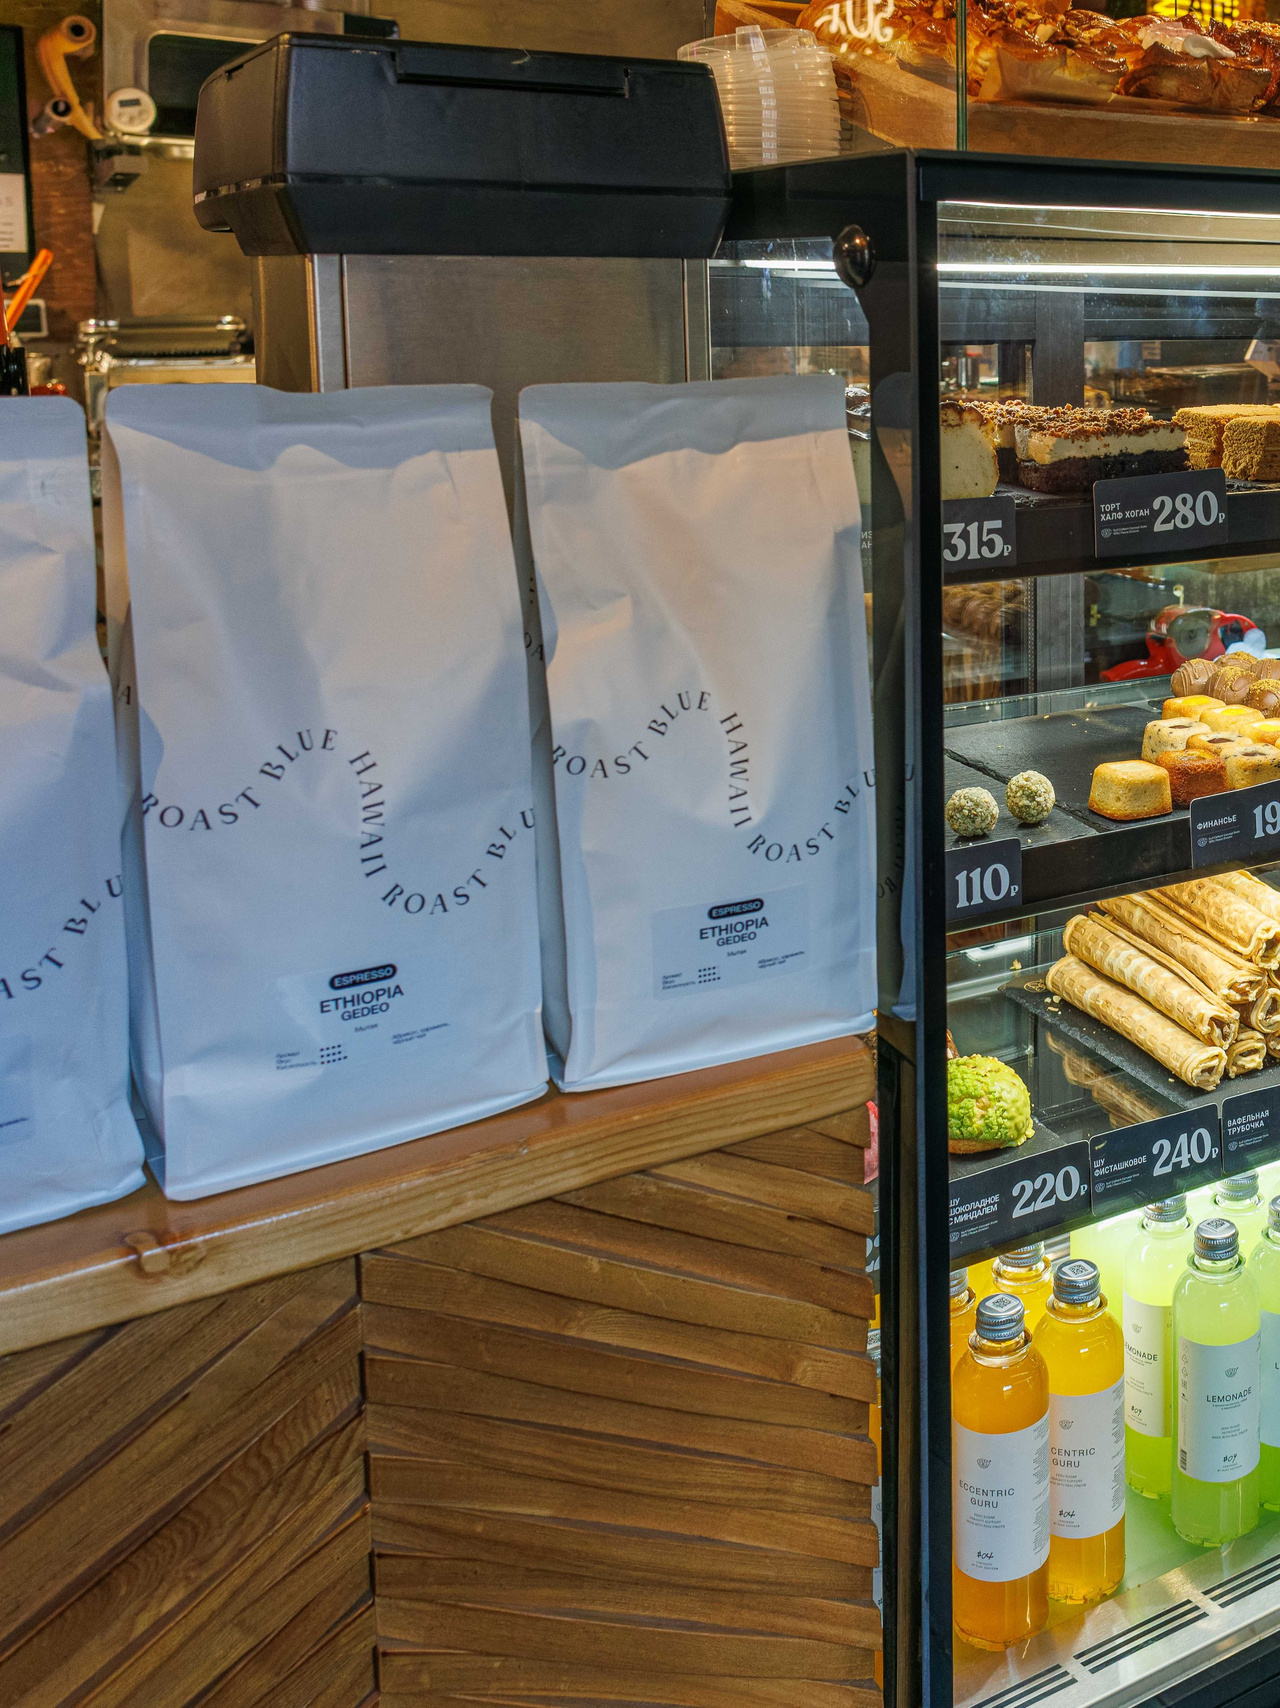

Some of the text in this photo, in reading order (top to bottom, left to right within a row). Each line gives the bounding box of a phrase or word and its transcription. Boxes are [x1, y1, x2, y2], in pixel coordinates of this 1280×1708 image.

[1100, 502, 1120, 512] ТОРТ
[1100, 512, 1124, 521] ХАЛФ
[1125, 508, 1150, 518] ХОГАН
[553, 690, 876, 863] ROAST BLUE HAWAII ROAST BLU
[142, 729, 536, 915] ROAST BLUE HAWAII ROAST BLU
[1196, 814, 1237, 830] ФИНАНСЬЕ
[712, 900, 761, 917] ESPRESSO
[0, 874, 123, 999] AST BLU
[699, 916, 769, 940] ETHIOPIA
[716, 931, 757, 947] GEDEO
[333, 966, 394, 988] ESPRESSO
[319, 985, 404, 1014] ETHIOPIA
[341, 1002, 390, 1021] GEDEO
[1227, 1109, 1270, 1127] ВАФЕЛЬНАЯ
[1227, 1120, 1265, 1136] ТРУБОЧКА
[1093, 1158, 1105, 1168] ШУ
[1094, 1155, 1147, 1176] ФИСТАШКОВОЕ
[954, 1203, 998, 1224] МИНДАЛЕМ
[1125, 1341, 1158, 1361] EMONADE
[1206, 1386, 1252, 1403] LEMONADE
[1051, 1446, 1096, 1458] CENTRIC
[1223, 1453, 1238, 1463] #09
[1052, 1458, 1080, 1468] GURU
[959, 1479, 1015, 1497] ECCENTRIC
[970, 1497, 999, 1509] GURU
